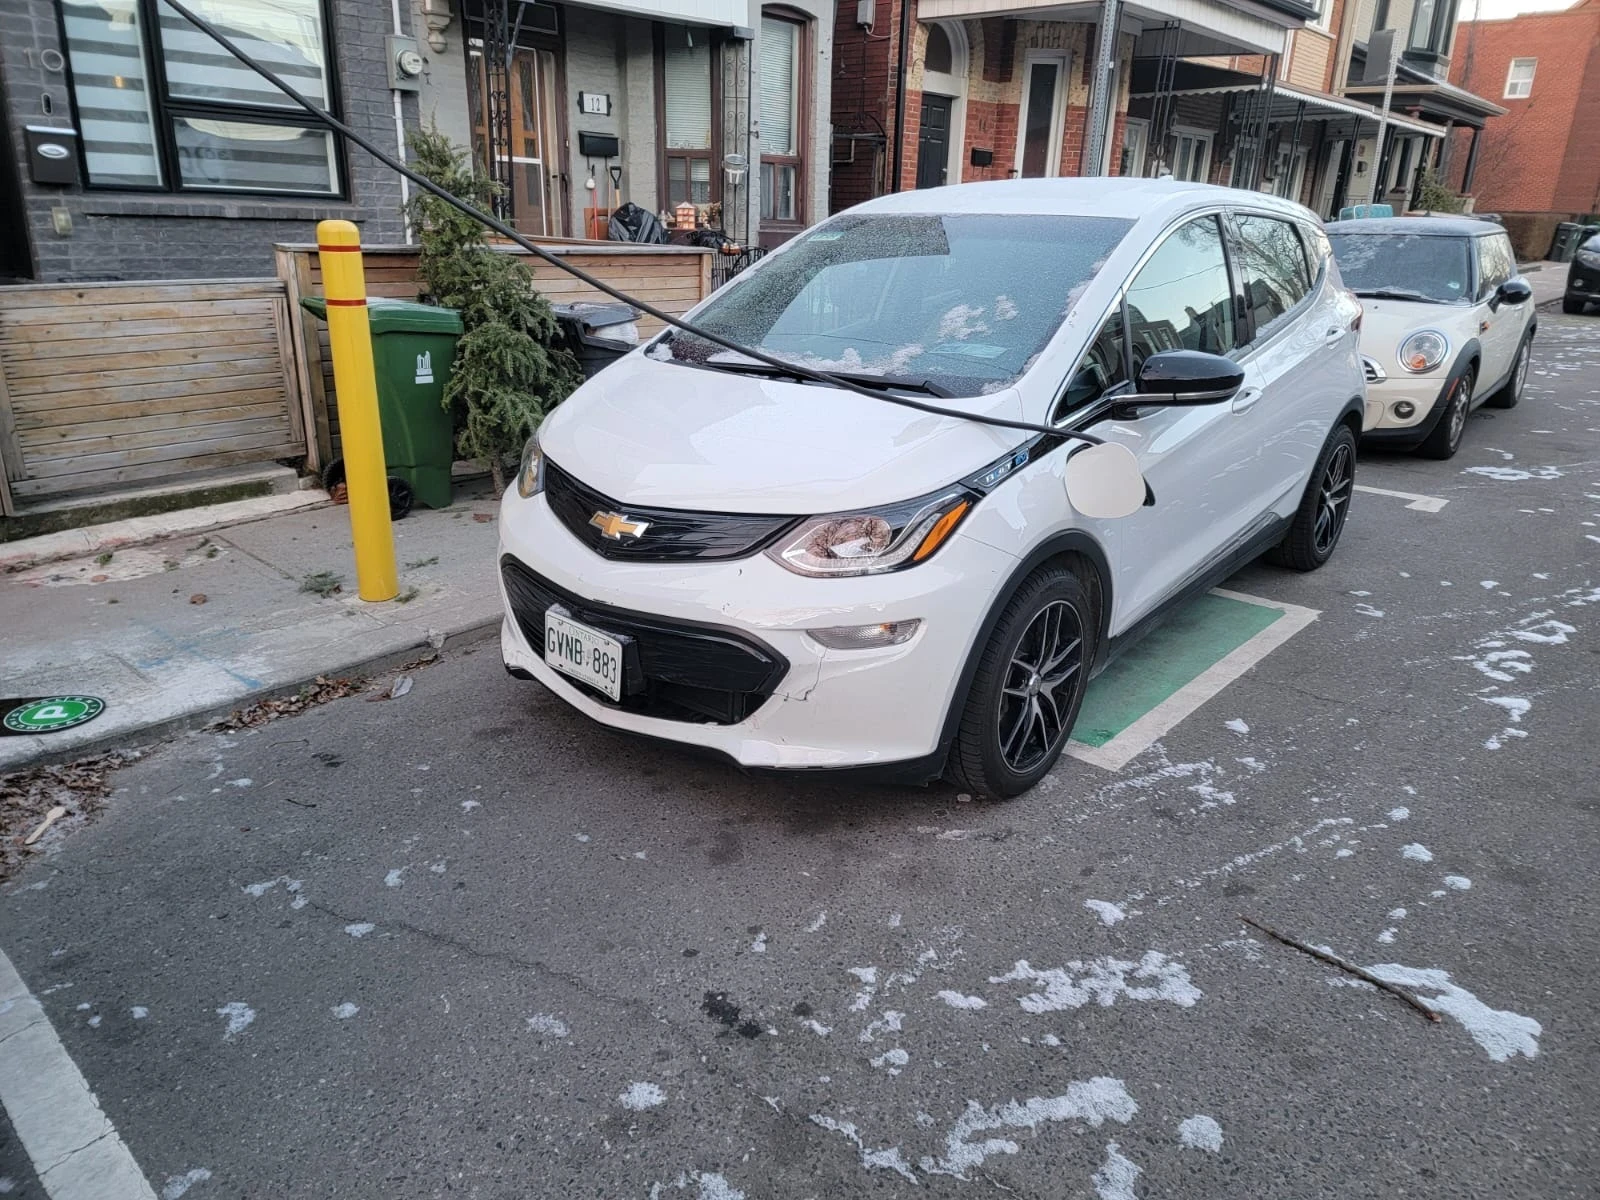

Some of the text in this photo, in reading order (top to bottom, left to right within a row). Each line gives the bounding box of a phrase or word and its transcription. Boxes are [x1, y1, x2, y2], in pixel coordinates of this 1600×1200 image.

[591, 97, 600, 111] 12
[547, 626, 583, 666] GVNB
[592, 647, 617, 684] 883
[31, 705, 69, 720] P
